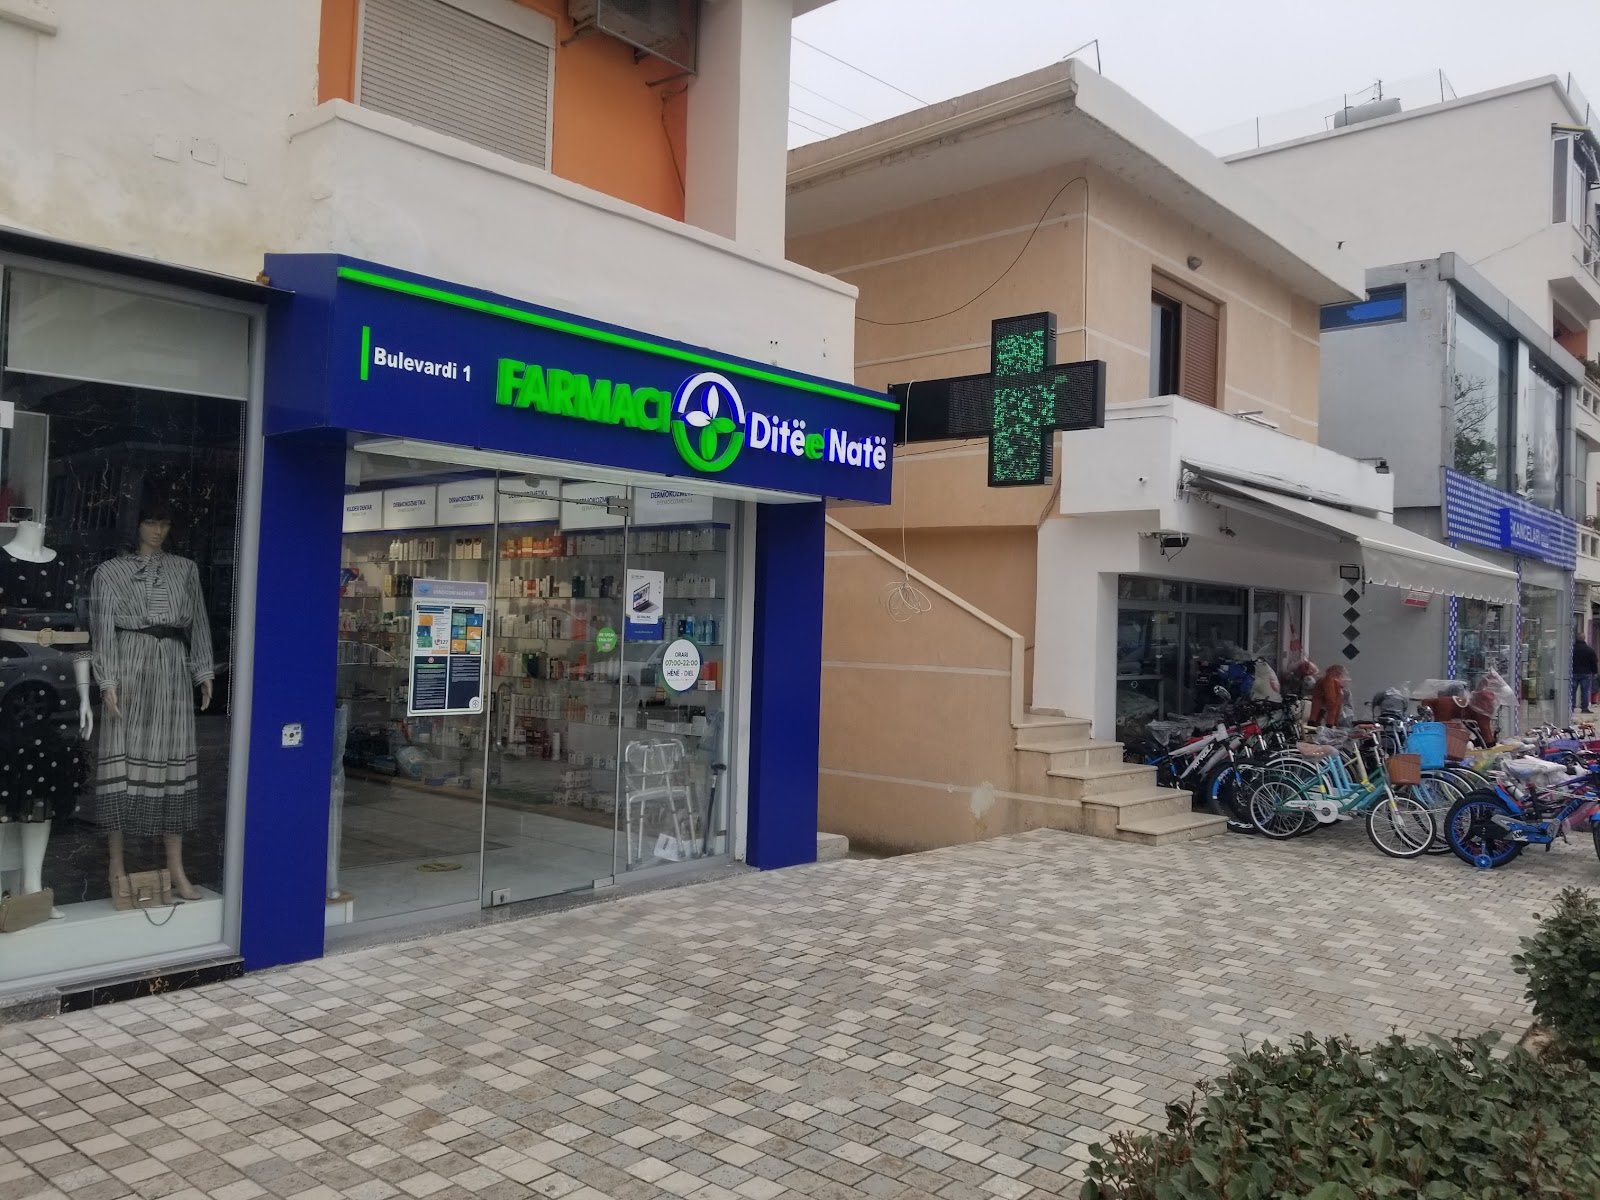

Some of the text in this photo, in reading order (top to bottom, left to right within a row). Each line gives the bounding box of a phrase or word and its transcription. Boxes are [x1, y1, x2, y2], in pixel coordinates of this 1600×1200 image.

[374, 346, 471, 382] Bulevardi 1
[496, 358, 671, 433] FARMACI
[825, 429, 887, 470] Natë
[667, 669, 680, 677] HËNË
